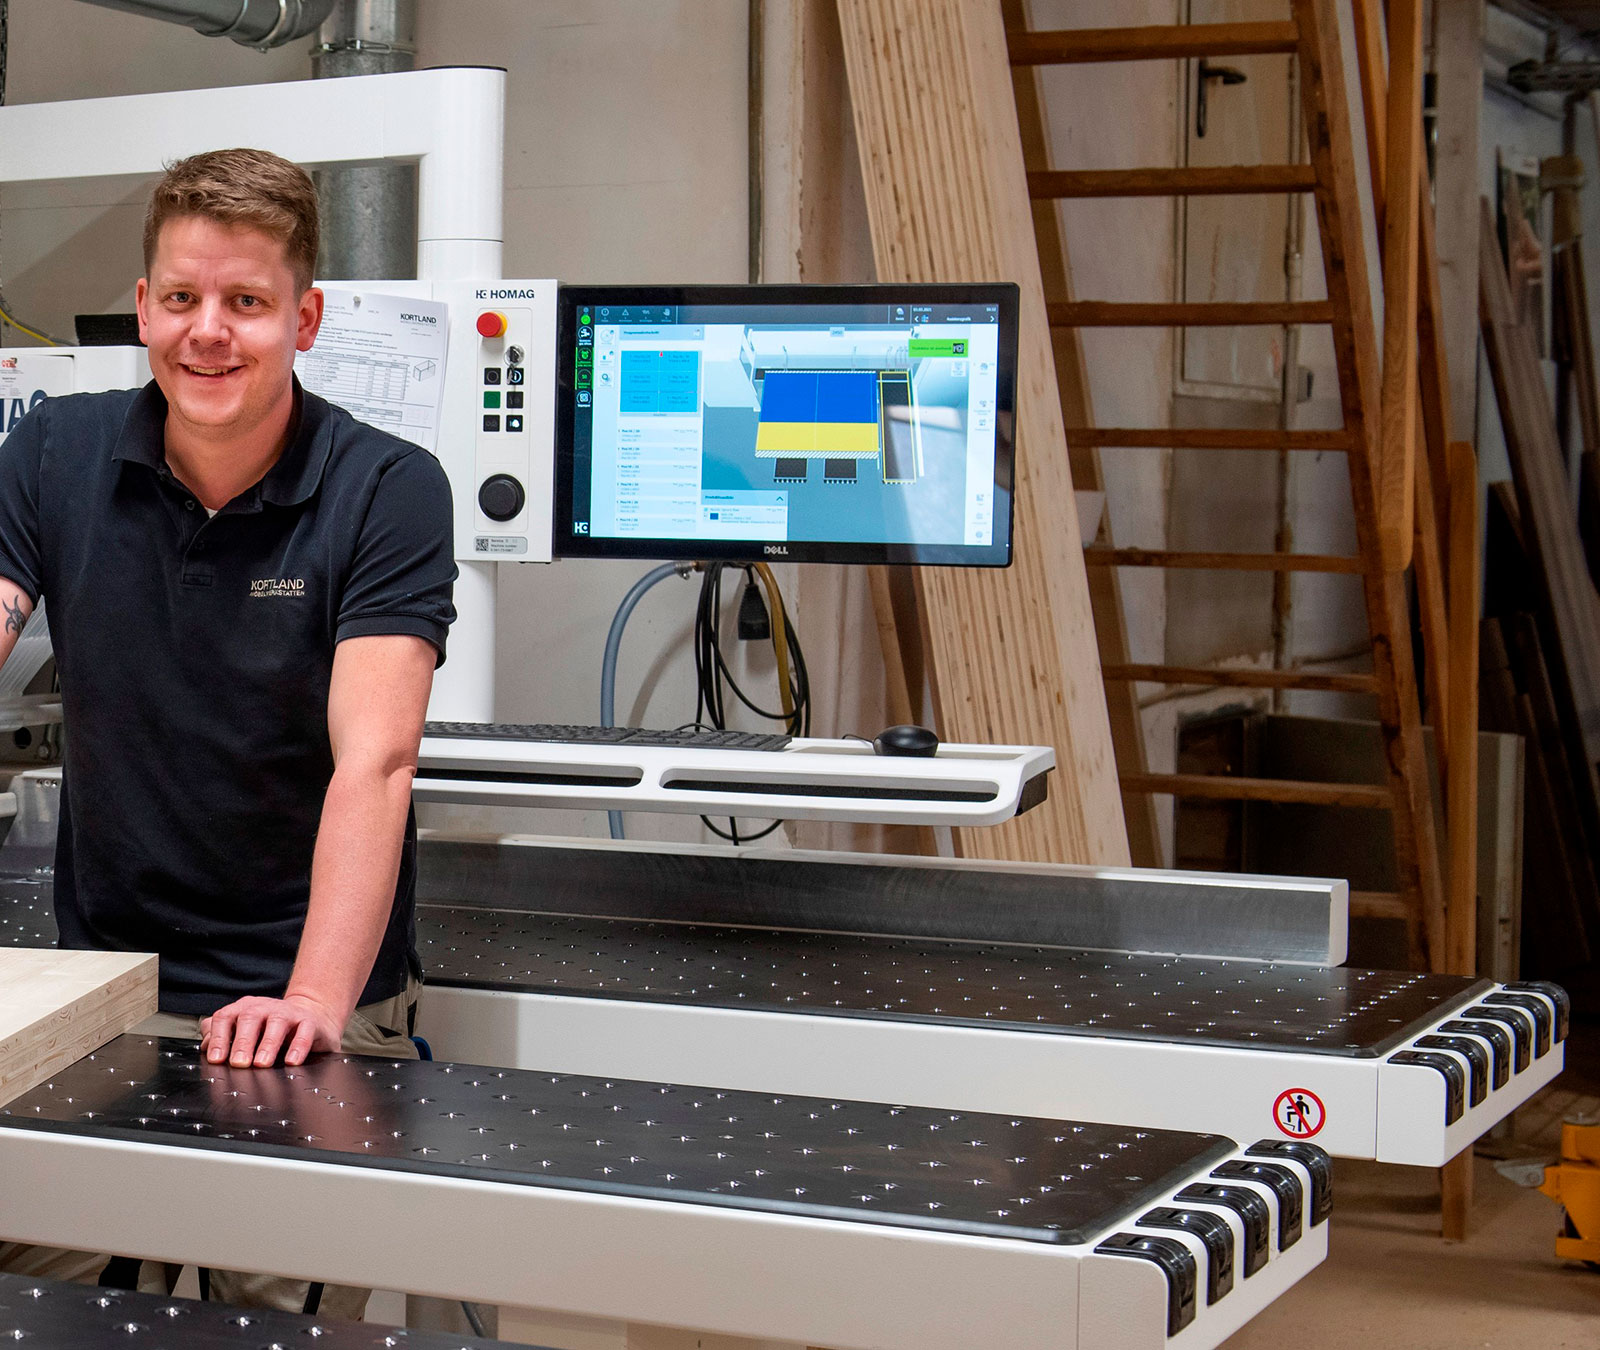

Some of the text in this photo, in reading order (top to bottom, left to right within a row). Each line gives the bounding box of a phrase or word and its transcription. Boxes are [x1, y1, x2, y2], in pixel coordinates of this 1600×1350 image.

[490, 289, 535, 299] HOMAG
[400, 313, 437, 325] KORTLAND
[763, 545, 789, 555] DELL
[250, 578, 305, 591] KORTLAND
